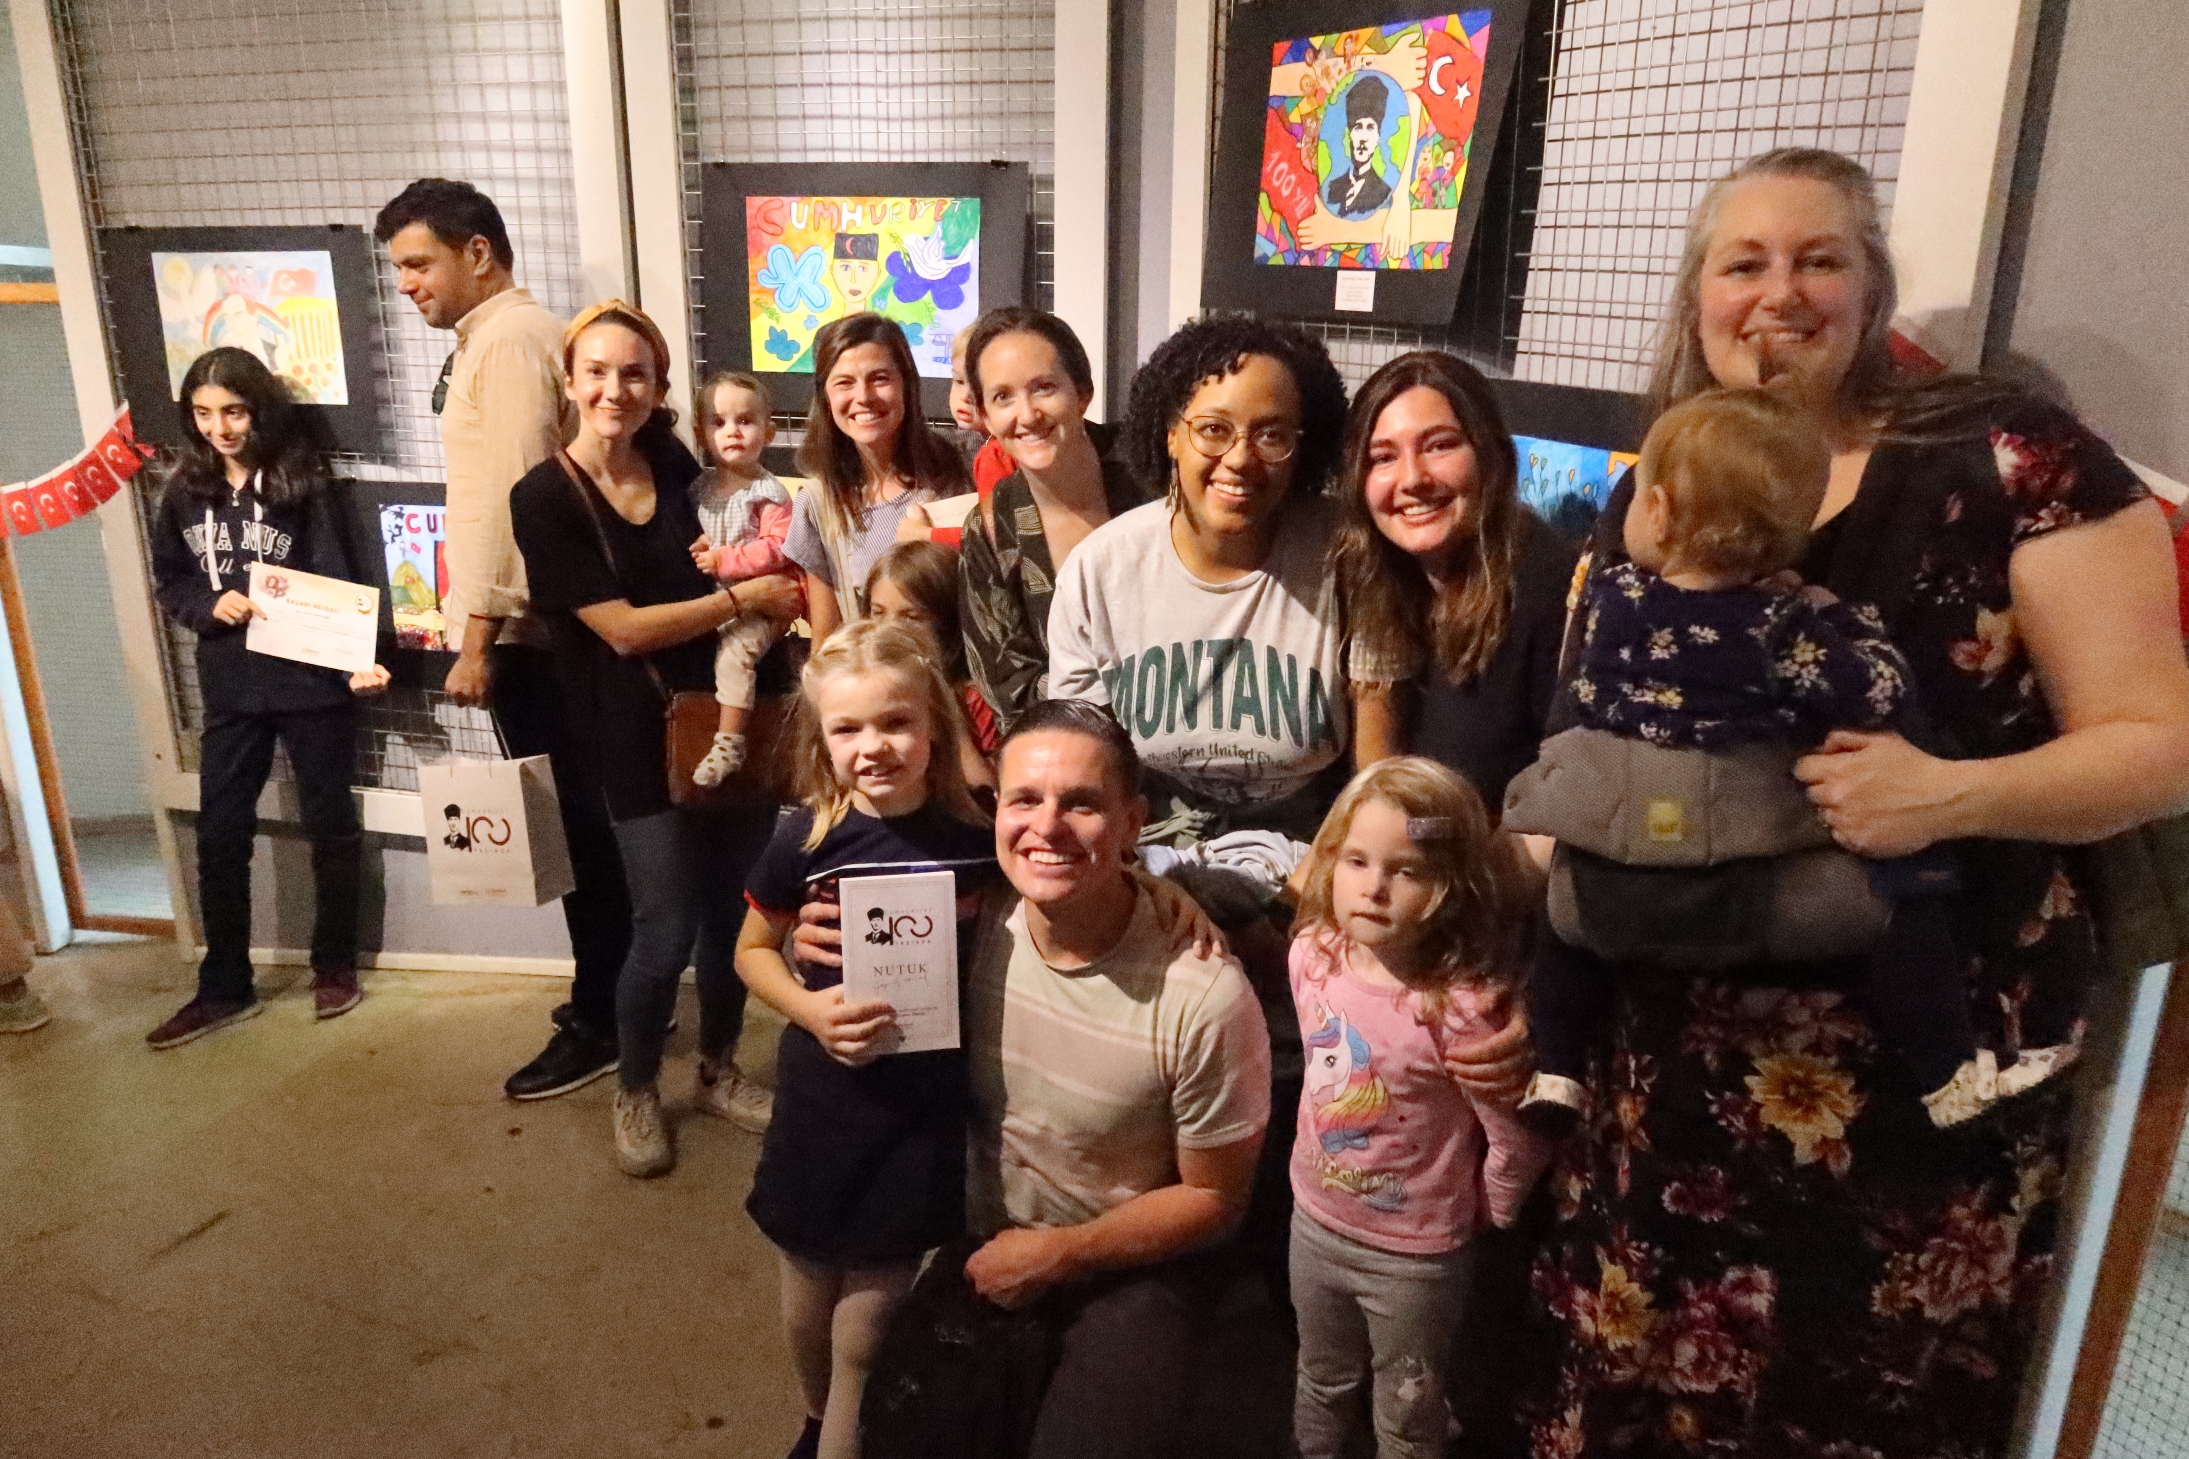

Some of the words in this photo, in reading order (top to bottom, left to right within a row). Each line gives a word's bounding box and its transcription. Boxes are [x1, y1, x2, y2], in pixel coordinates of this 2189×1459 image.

[1102, 638, 1339, 752] MONTANA
[1208, 742, 1254, 761] United
[873, 963, 927, 976] NUTUK
